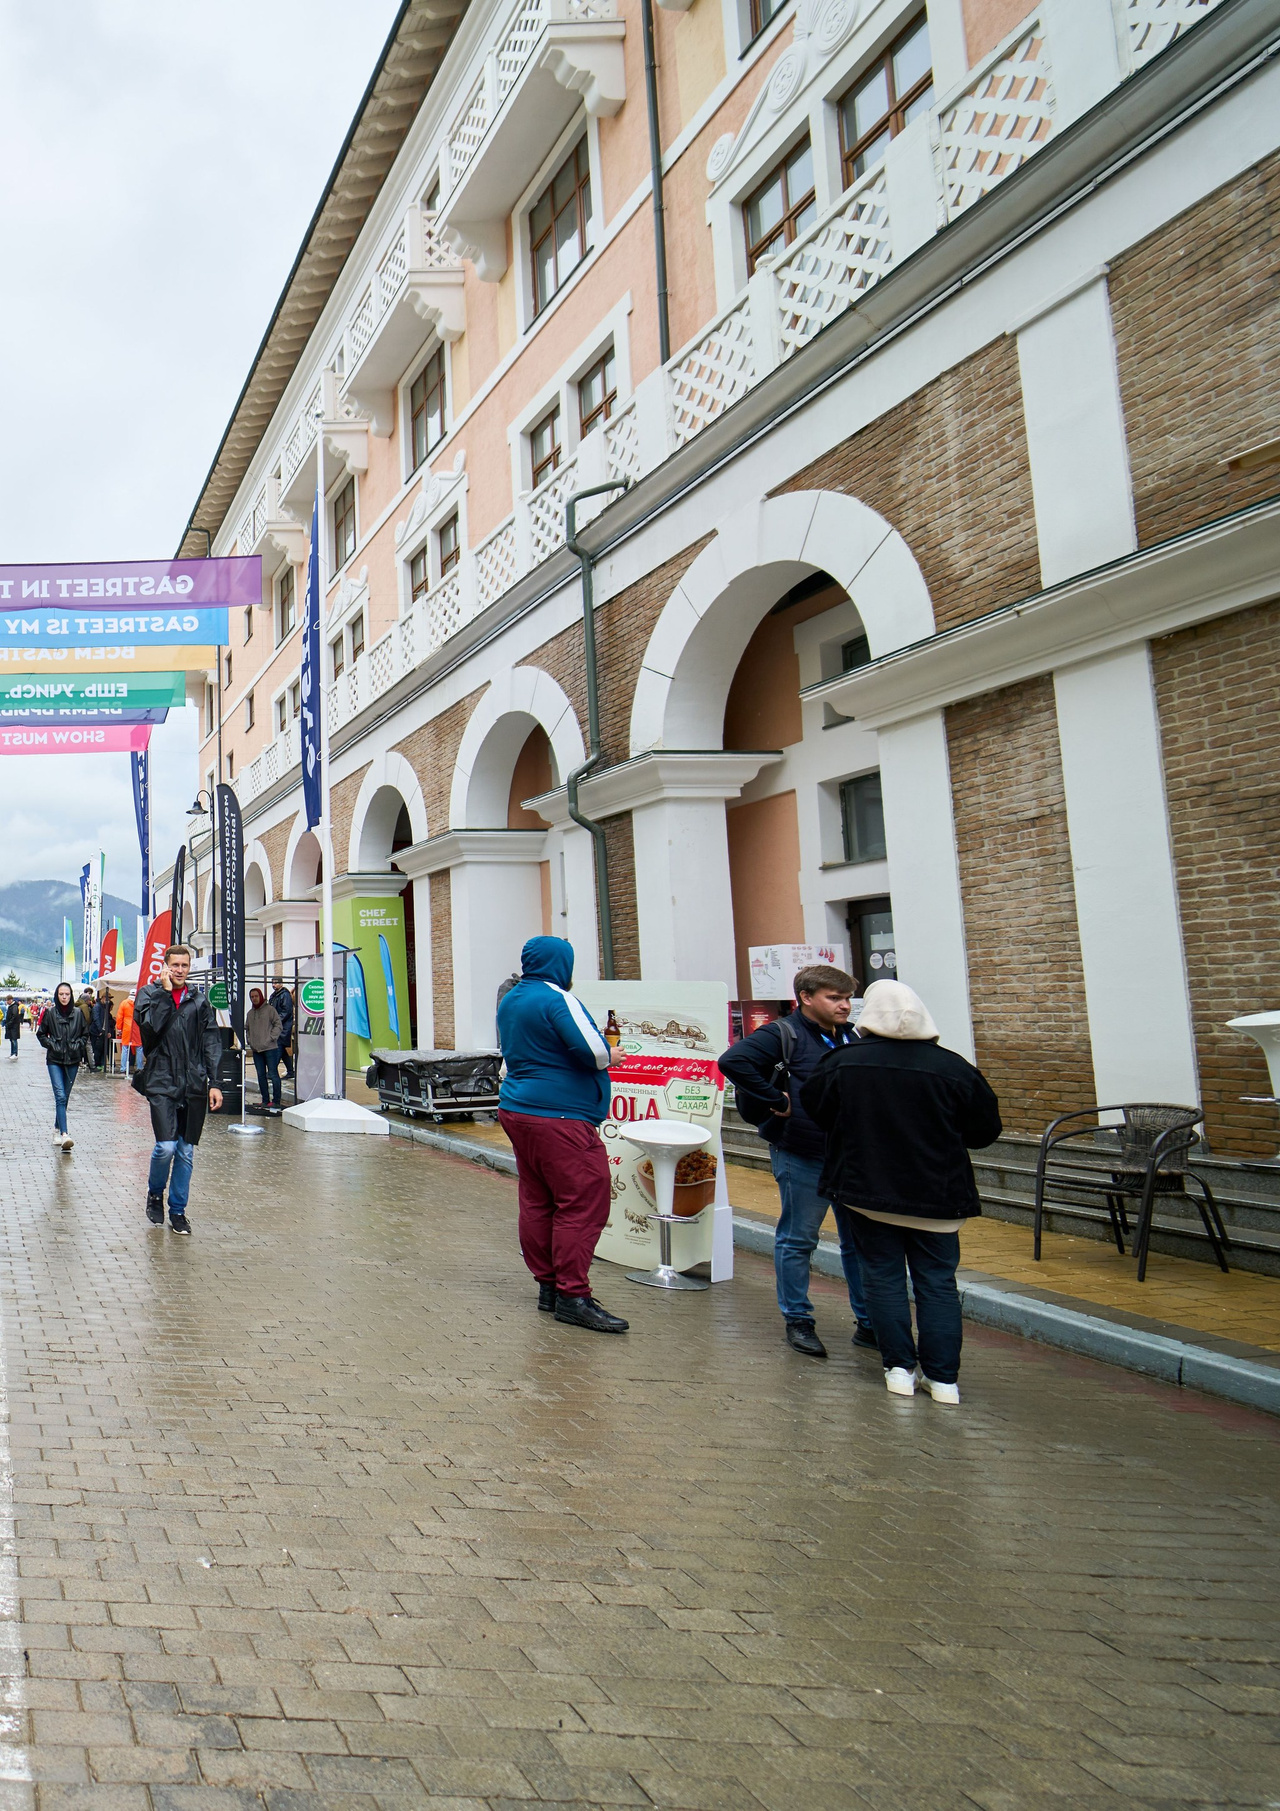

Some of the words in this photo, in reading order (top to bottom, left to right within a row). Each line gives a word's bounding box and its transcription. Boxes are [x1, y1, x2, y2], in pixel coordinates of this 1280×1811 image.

[359, 909, 387, 918] CHEF
[359, 918, 398, 927] STREET
[612, 1086, 658, 1096] ЗАПЕЧЕННЫЕ
[684, 1085, 701, 1095] БЕЗ
[607, 1095, 661, 1122] OLA
[677, 1101, 708, 1111] САХАРА
